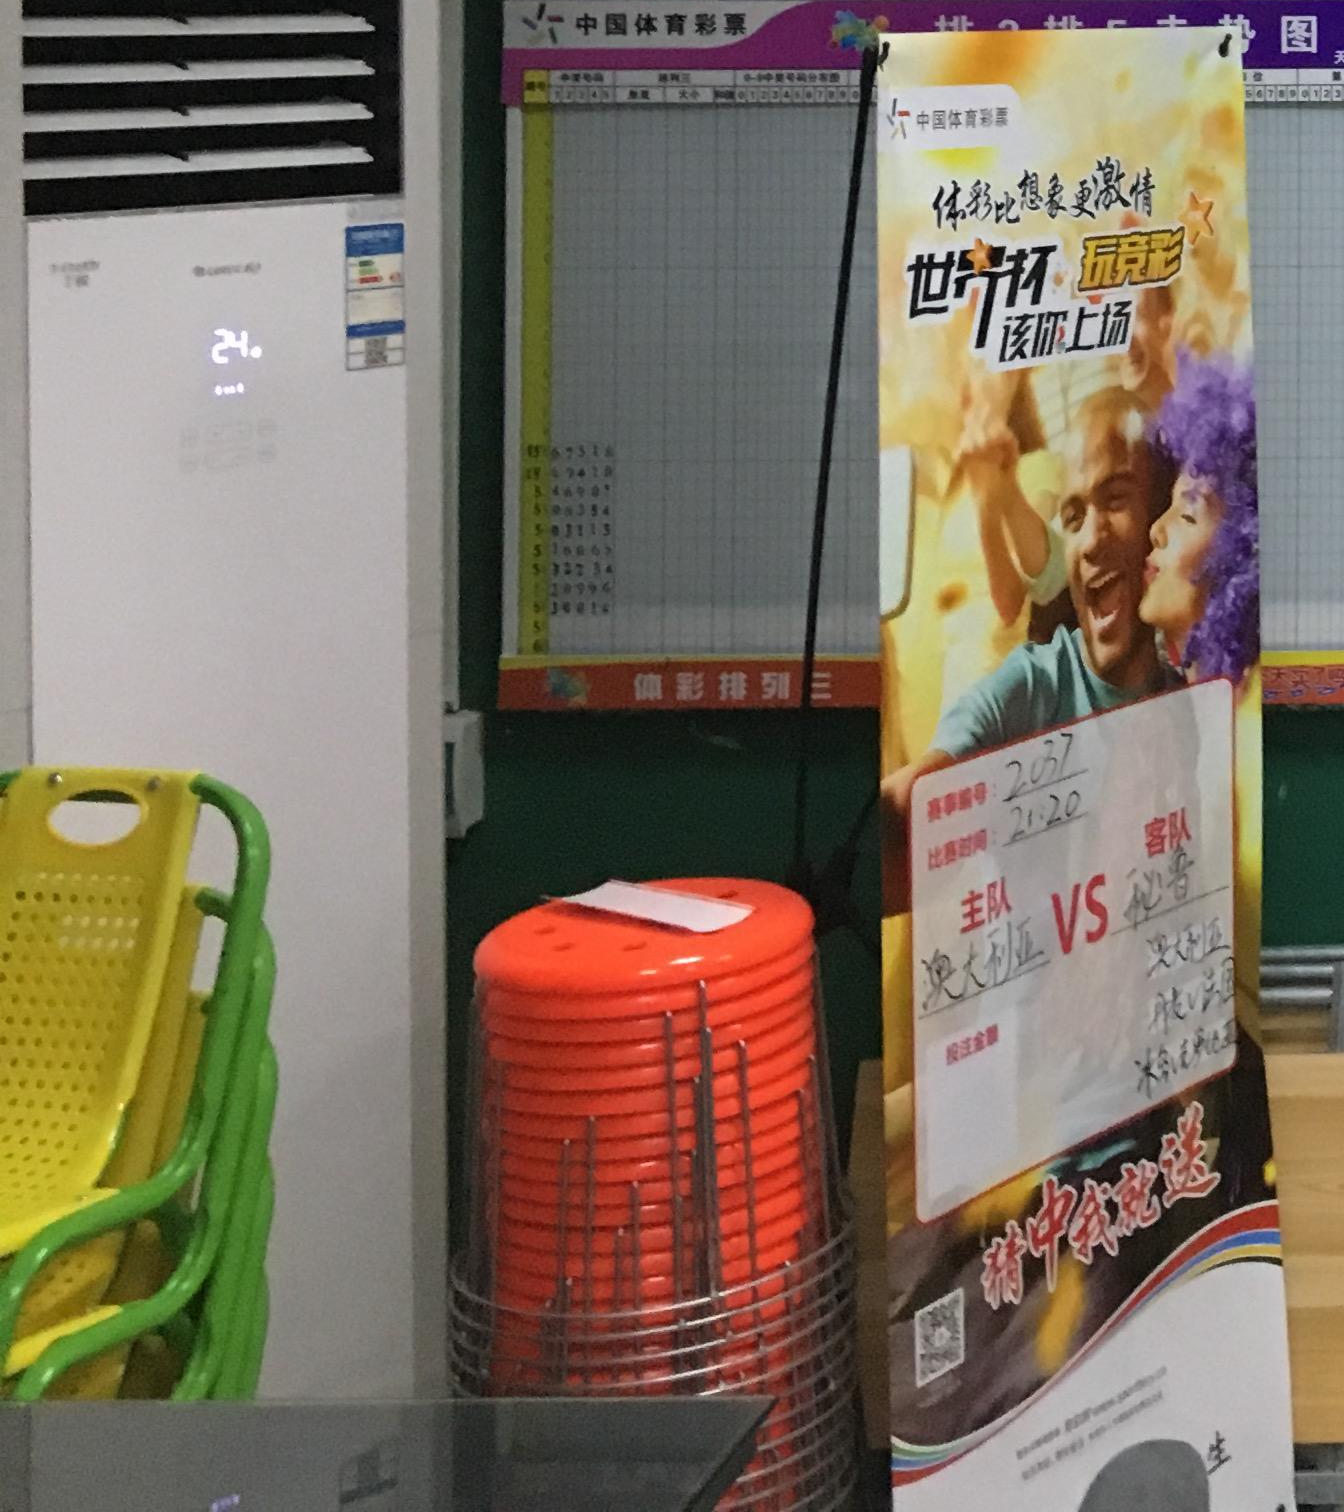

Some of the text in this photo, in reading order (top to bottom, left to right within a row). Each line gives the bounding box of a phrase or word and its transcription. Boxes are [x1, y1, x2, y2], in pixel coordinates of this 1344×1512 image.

[574, 12, 747, 38] 中国体育彩票
[916, 106, 1009, 130] 中国体育彩票
[932, 155, 1156, 232] 体彩比想象更激情
[907, 226, 1186, 349] 世界杯 玩竞彩
[998, 299, 1133, 363] 该你上场
[1144, 807, 1193, 859] 客队
[959, 875, 1012, 935] 主队
[1050, 872, 1109, 955] VS
